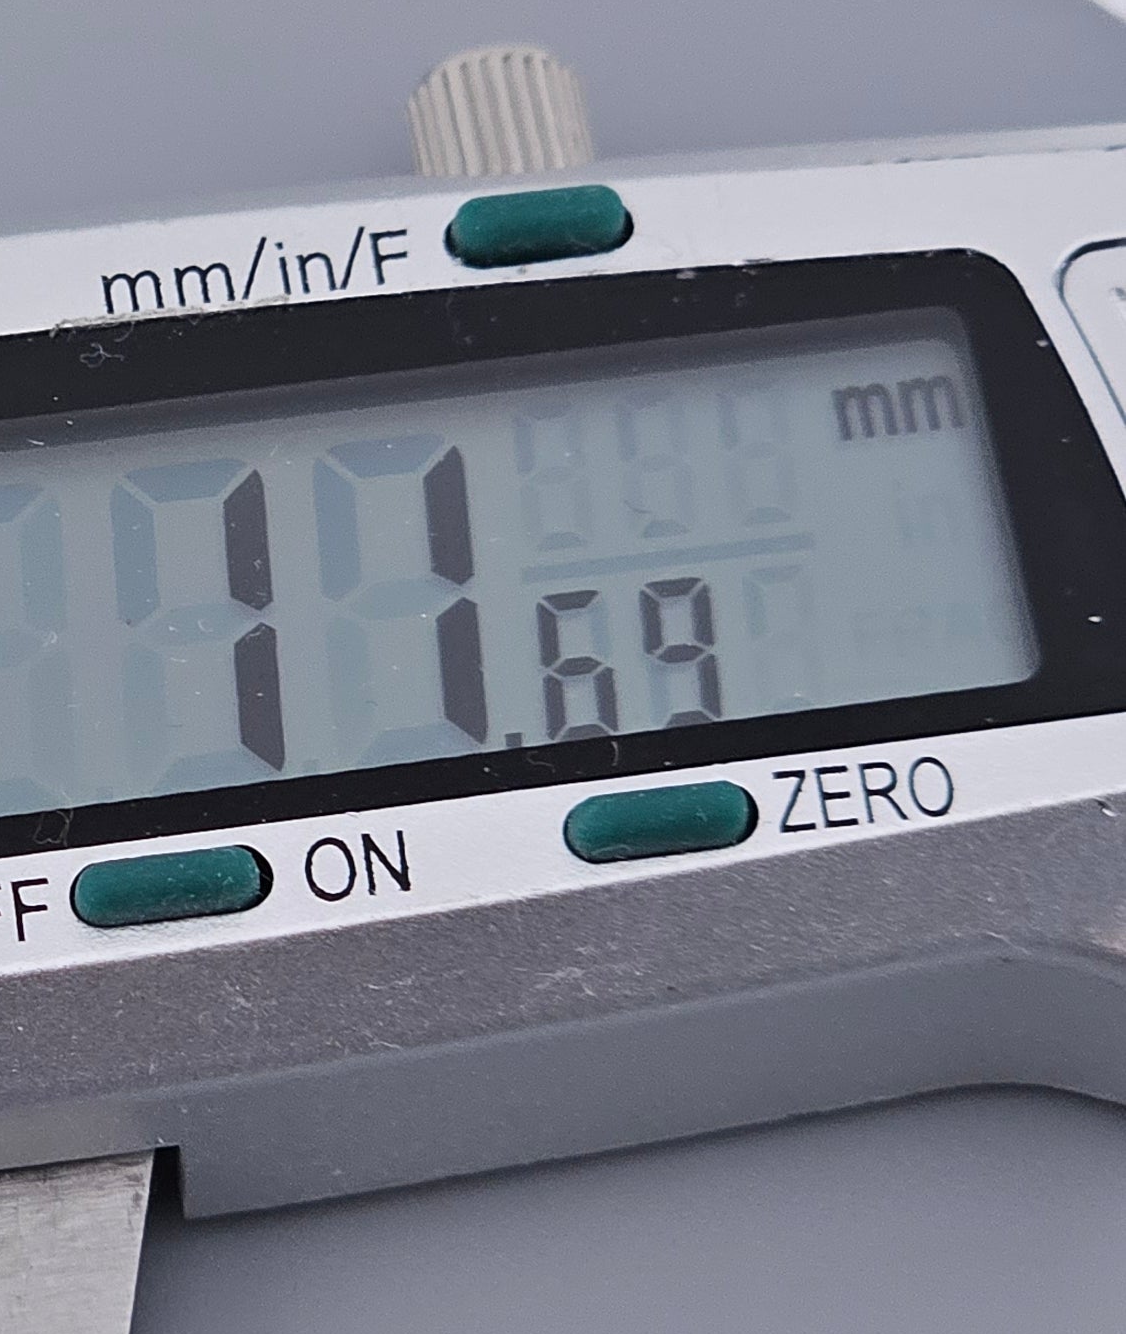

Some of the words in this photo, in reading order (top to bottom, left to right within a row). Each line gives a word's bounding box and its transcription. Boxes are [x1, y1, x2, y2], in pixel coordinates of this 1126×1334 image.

[101, 226, 408, 315] mm/in/F
[831, 372, 966, 442] mm
[222, 444, 724, 771] 11.69
[772, 755, 956, 834] ZERO
[304, 829, 412, 902] ON
